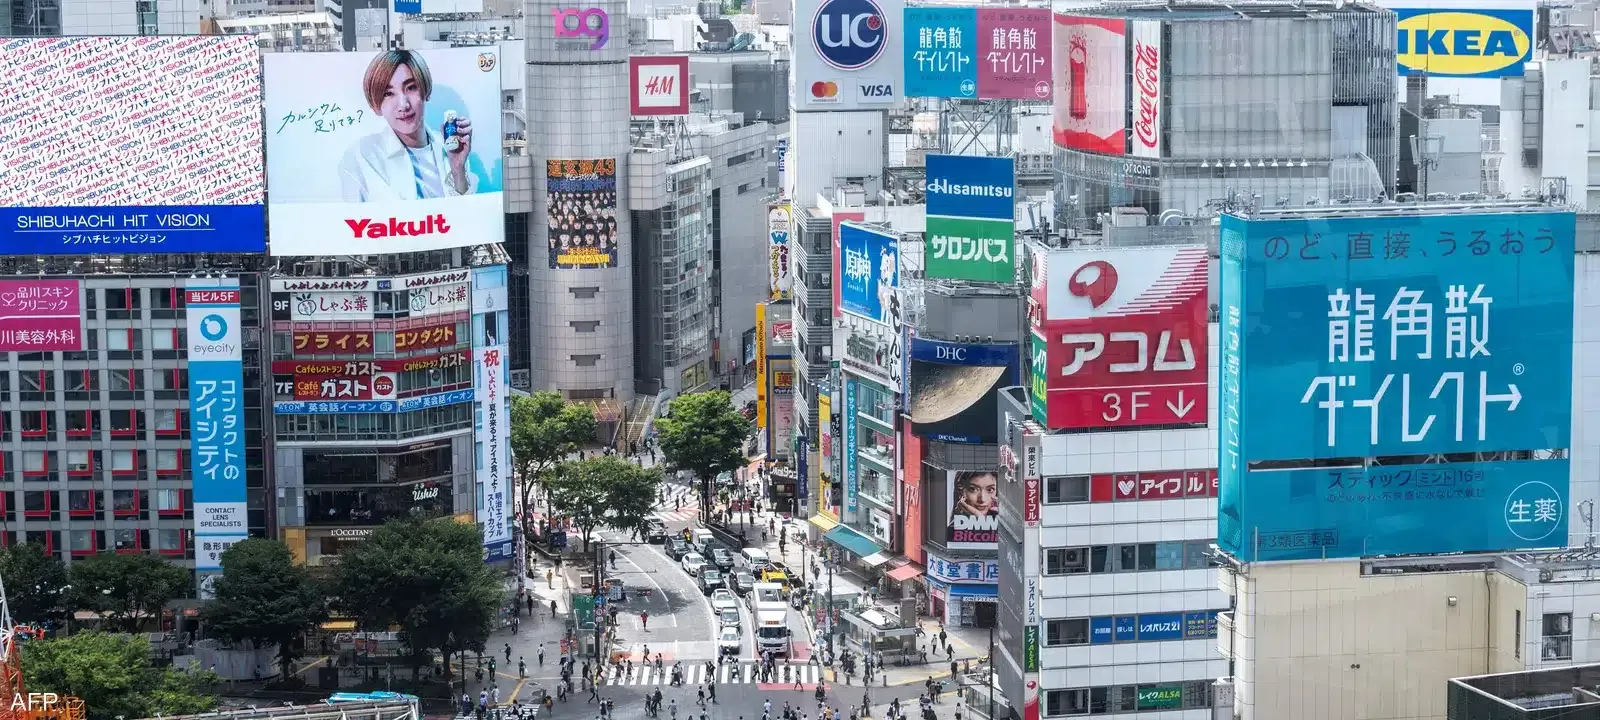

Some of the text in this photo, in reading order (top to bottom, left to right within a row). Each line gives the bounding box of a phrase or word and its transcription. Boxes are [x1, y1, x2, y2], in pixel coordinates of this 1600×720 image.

[551, 8, 609, 51] 109
[919, 26, 962, 49] 龍角散
[993, 27, 1037, 50] 龍角散
[1397, 29, 1519, 57] IKEA
[66, 44, 127, 73] SHIBUHACHI HIT
[77, 37, 169, 78] SHIBUHACHI HIT VISION
[913, 51, 970, 72] ダイレクト
[986, 52, 1045, 74] ダイレクト
[16, 62, 57, 83] HIT VISION
[33, 51, 161, 104] HIT VISION シブハチヒットビジョン
[43, 56, 170, 109] HIT VISION シブハチヒットビジョン
[9, 58, 186, 132] シブハチヒットビジョン SHIBUHACHI HIT VISION
[645, 76, 675, 95] H&M
[860, 84, 893, 97] VISA
[1134, 38, 1159, 148] Coca-Cola
[11, 48, 256, 148] SHIBUHACHI HIT VISION シブハチヒットビジョン SHIBUHACHI HIT
[21, 60, 251, 153] SHIBUHACHI HIT VISION シブハチヒットビジョン SHIBUHACHI
[5, 83, 214, 169] VISION シブハチヒットビジョン SHIBUHACHI HIT VISION
[277, 103, 341, 134] カルシウム
[39, 102, 215, 174] SHIBUHACHI HIT VISION シブハチヒットビジョン
[16, 108, 241, 200] HIT VISION シブハチヒットビジョン SHIBUHACHI HIT VISION
[927, 178, 1012, 198] Hisamitsu
[17, 213, 210, 228] SHIBUHACHI HIT VISION
[345, 214, 451, 239] Yakult
[63, 234, 166, 244] シブハチヒットビジョン
[931, 233, 1009, 264] サロンパス
[1264, 228, 1557, 261] のど、直接、うるおう
[845, 241, 872, 288] 原神
[284, 281, 369, 291] しゃぶしゃぶバイキング
[405, 271, 468, 288] しゃぶしゃぶバイキング
[17, 286, 74, 299] 品川スキン
[191, 291, 235, 302] 当ビル5F
[429, 286, 466, 305] しゃぶ葉
[18, 299, 68, 311] クリニック
[274, 301, 289, 311] 9F
[320, 296, 368, 311] しゃぶ葉
[1327, 284, 1494, 363] 龍角散
[0, 330, 75, 345] 川美容外科
[294, 333, 372, 349] プライス
[395, 327, 453, 347] コンタクト
[194, 342, 236, 355] eyecity
[484, 349, 500, 368] 祝
[936, 346, 967, 361] DHC
[1061, 330, 1196, 377] アコム
[345, 361, 382, 376] ガスト
[439, 353, 467, 368] ガスト
[277, 383, 293, 393] 7F
[298, 381, 318, 391] Café
[321, 380, 368, 399] ガスト
[308, 402, 377, 413] 英会話イーオン
[423, 391, 474, 408] 英会話イーオン
[1102, 391, 1152, 422] 3F
[1300, 370, 1523, 447] ダイレクト
[195, 380, 219, 481] アイシティ
[221, 380, 240, 480] コンタクトの
[1141, 477, 1203, 496] アイフル
[1328, 471, 1412, 489] スティック
[1419, 470, 1452, 484] ミント
[495, 491, 503, 537] 明治エッセル
[1028, 489, 1037, 520] アイフル
[1508, 498, 1558, 524] 生薬
[487, 494, 495, 538] スーパーカップ
[203, 542, 236, 551] 隐形眼
[1256, 530, 1337, 550] 第3類医薬品
[929, 556, 999, 581] 大盛堂書店
[1028, 579, 1036, 623] レオパレス21
[1140, 621, 1180, 633] レオパレス21
[1028, 626, 1036, 671] レイクALSA
[1139, 690, 1181, 700] レイクALSA
